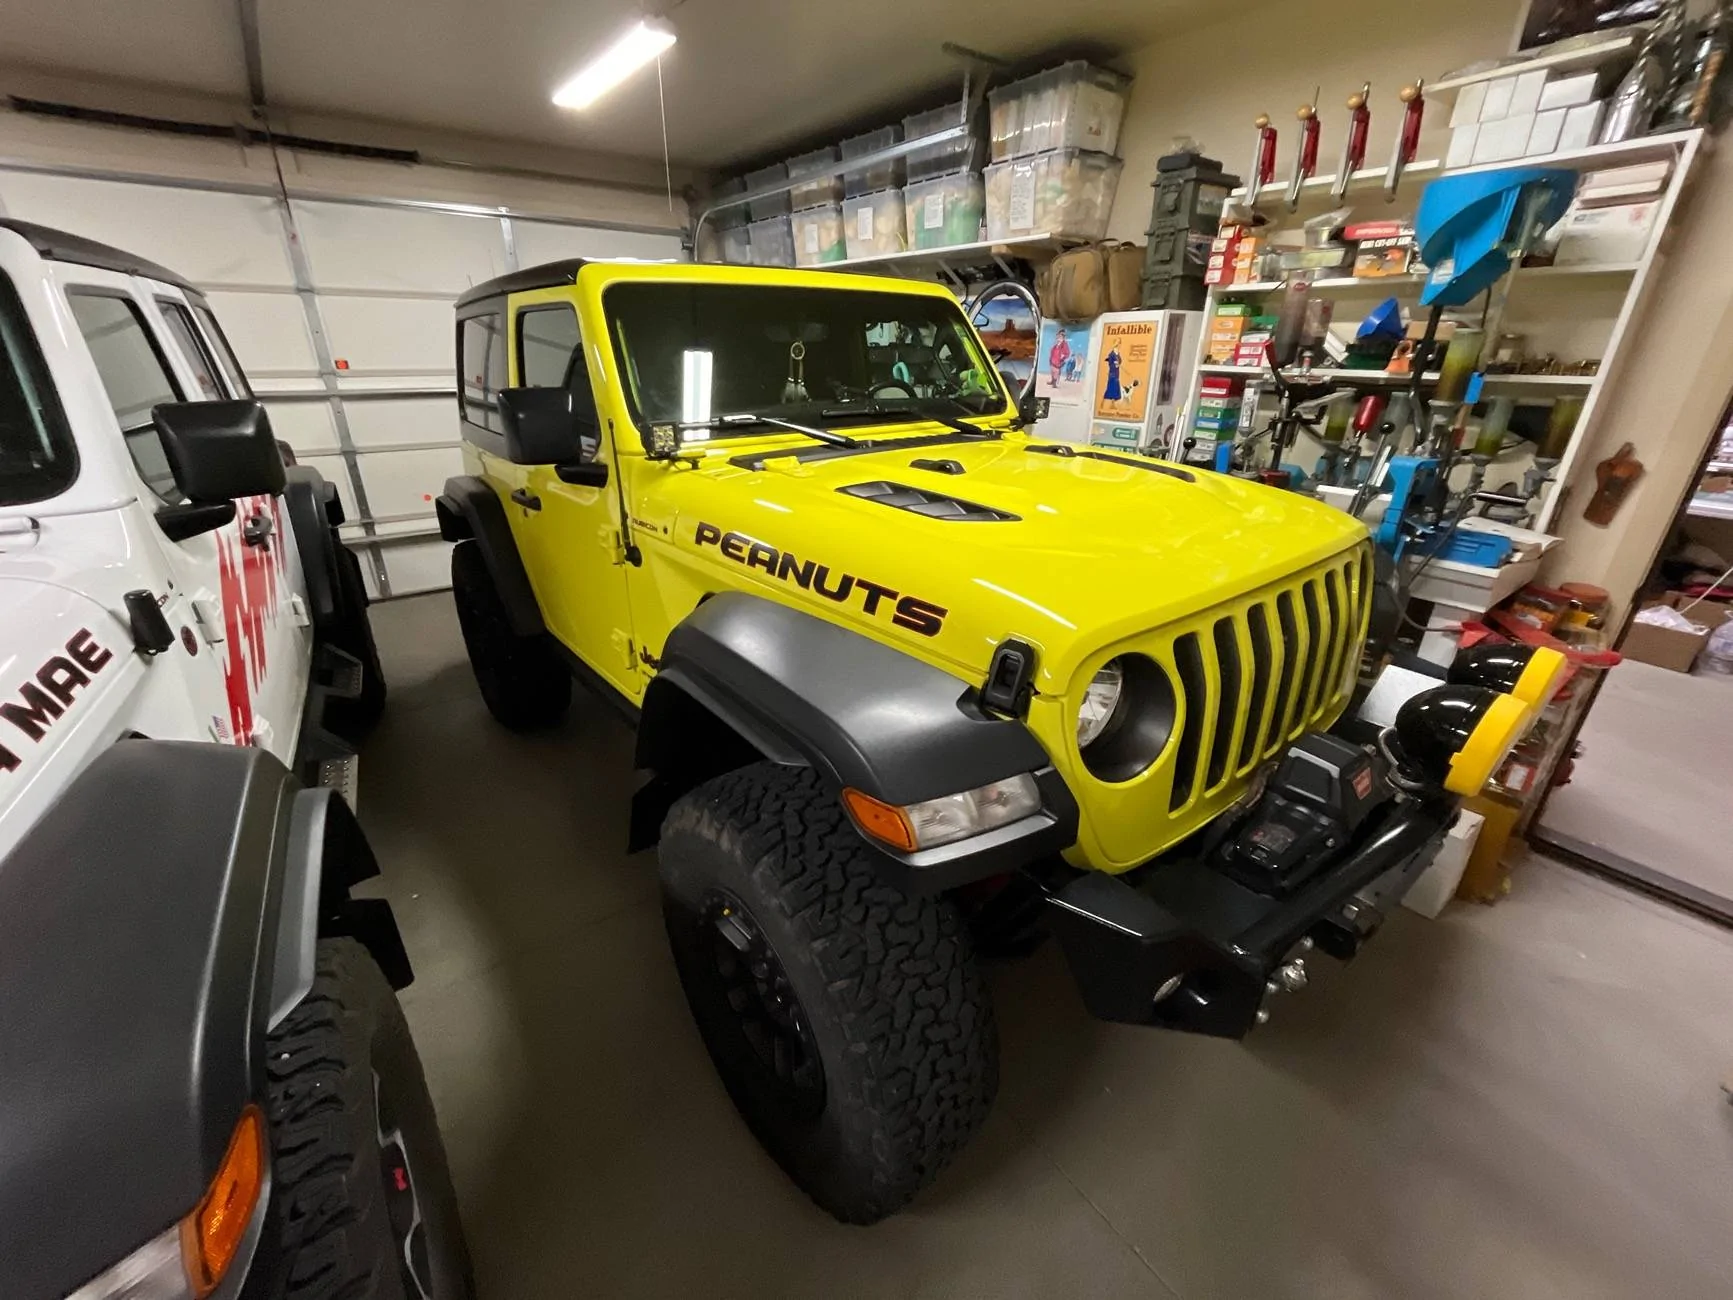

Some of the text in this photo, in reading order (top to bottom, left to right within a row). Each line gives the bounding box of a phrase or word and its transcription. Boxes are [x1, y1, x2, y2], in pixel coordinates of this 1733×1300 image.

[1107, 324, 1152, 335] Infallible
[695, 521, 948, 637] PEANUTS
[0, 627, 113, 743] MAE
